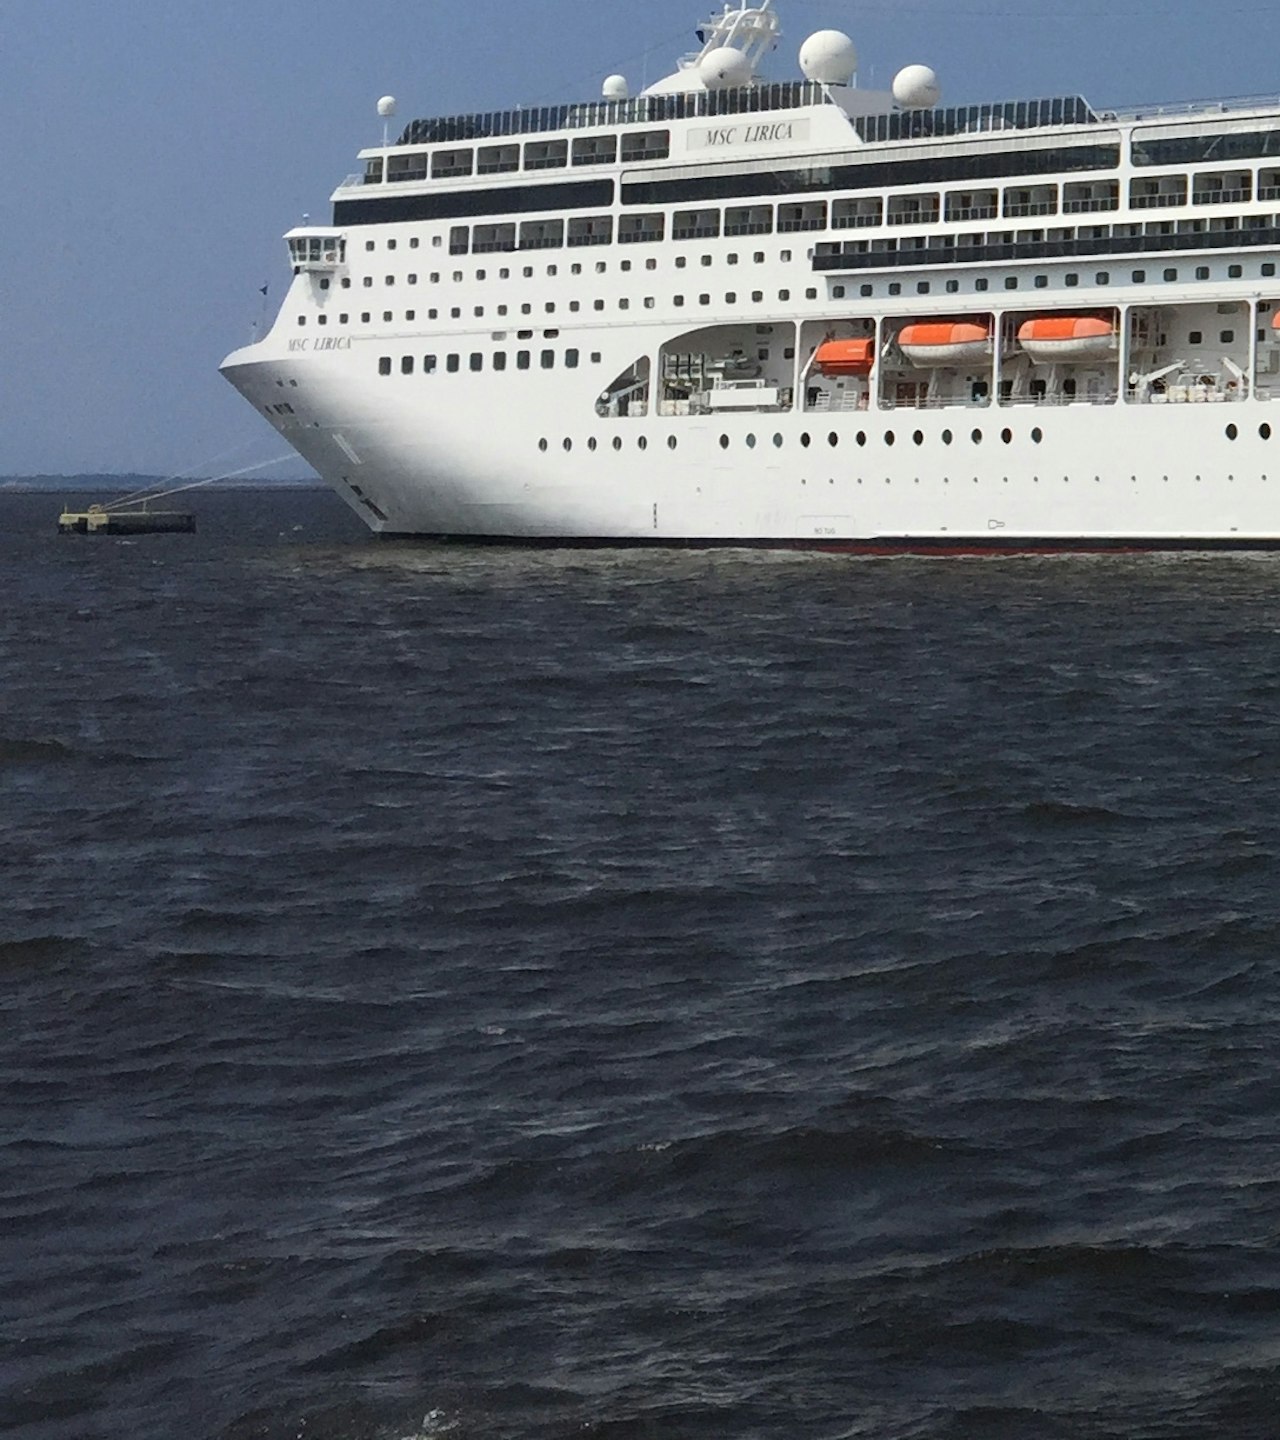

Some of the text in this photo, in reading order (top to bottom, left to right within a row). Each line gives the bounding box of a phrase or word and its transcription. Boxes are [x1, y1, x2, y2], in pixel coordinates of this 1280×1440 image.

[705, 123, 793, 146] MSC LIRICA
[286, 336, 351, 352] MSC LIRICA
